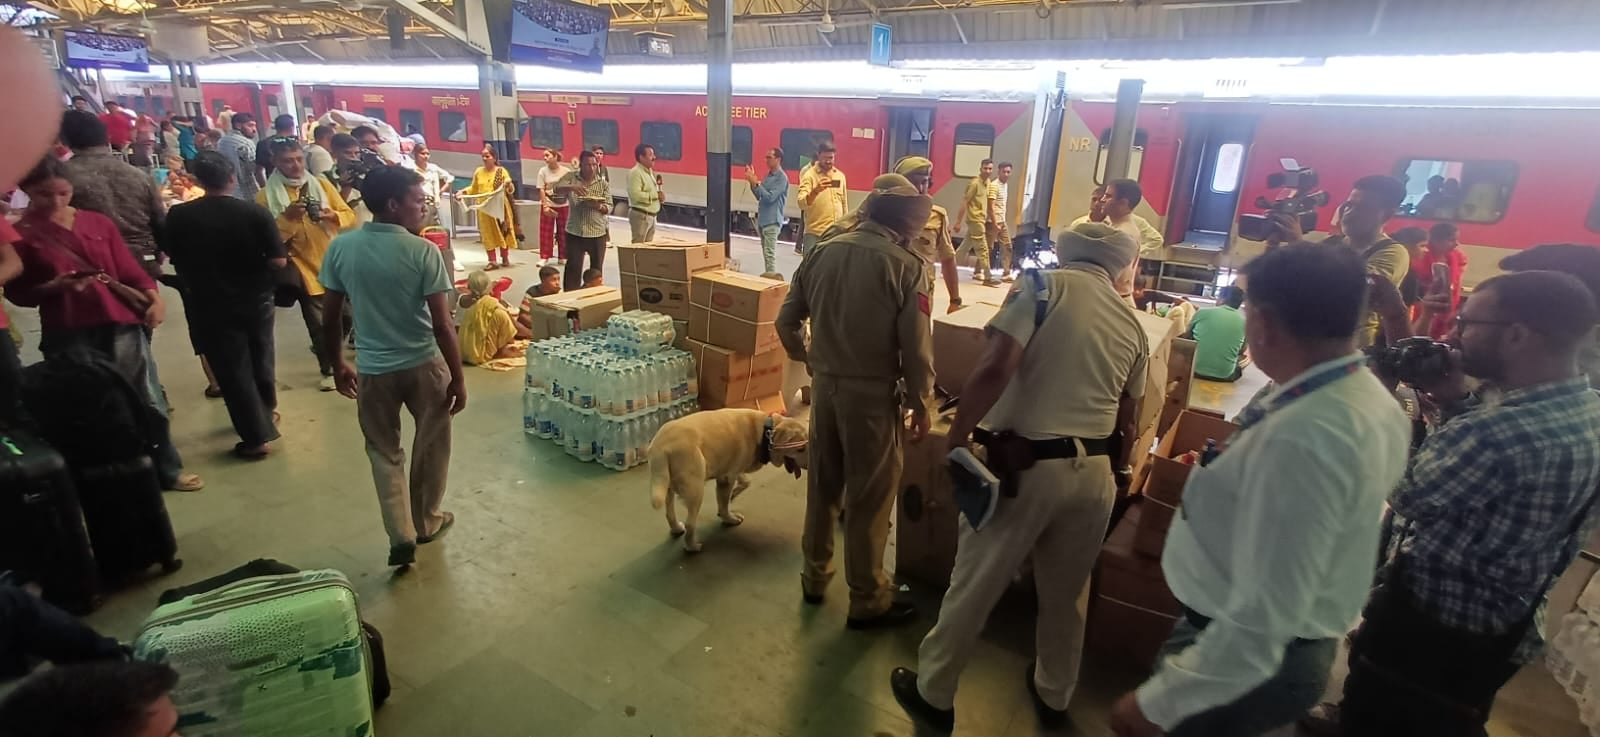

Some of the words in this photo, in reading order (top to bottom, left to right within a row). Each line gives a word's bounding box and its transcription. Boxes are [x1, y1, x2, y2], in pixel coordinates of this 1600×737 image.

[878, 33, 884, 57] 1
[744, 106, 767, 119] TIER
[1069, 136, 1091, 152] NR
